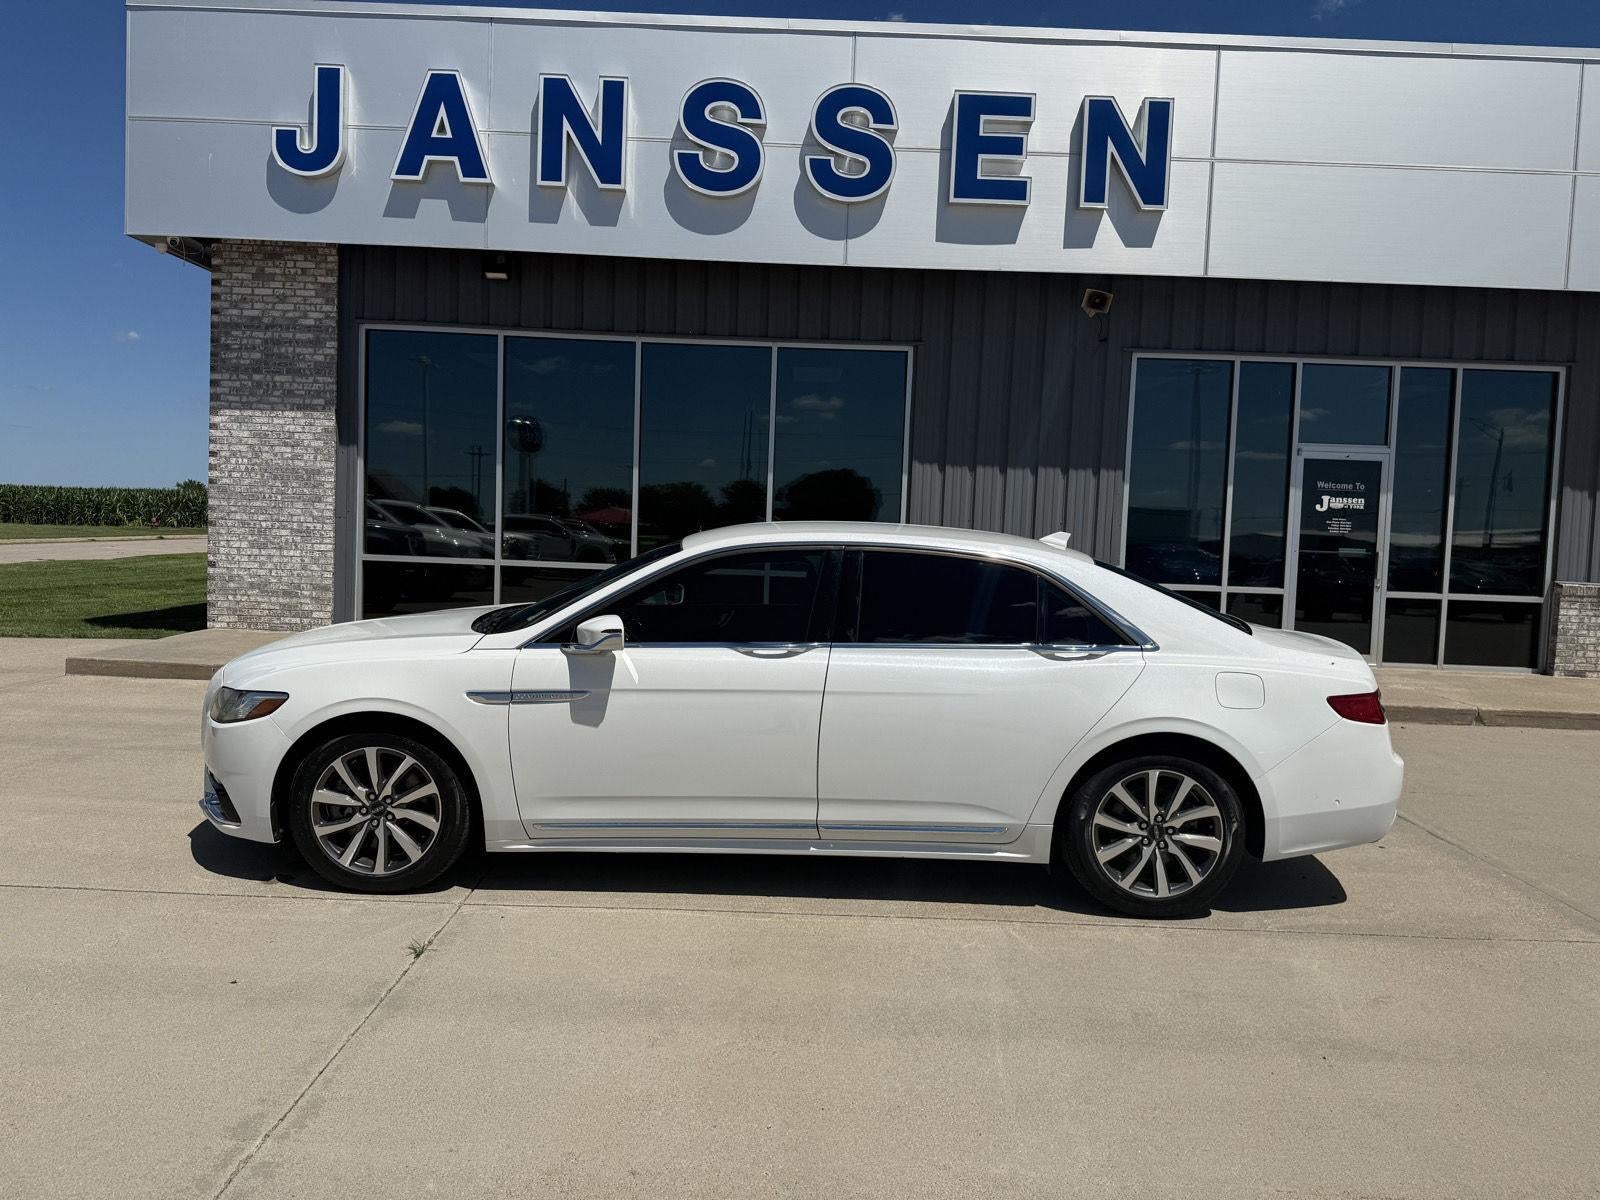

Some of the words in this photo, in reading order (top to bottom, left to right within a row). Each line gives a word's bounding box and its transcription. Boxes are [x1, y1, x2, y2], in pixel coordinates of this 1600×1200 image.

[270, 63, 1175, 212] JANSSEN
[1317, 481, 1353, 489] Welcome
[1355, 482, 1365, 490] To
[1315, 495, 1365, 511] Janssen
